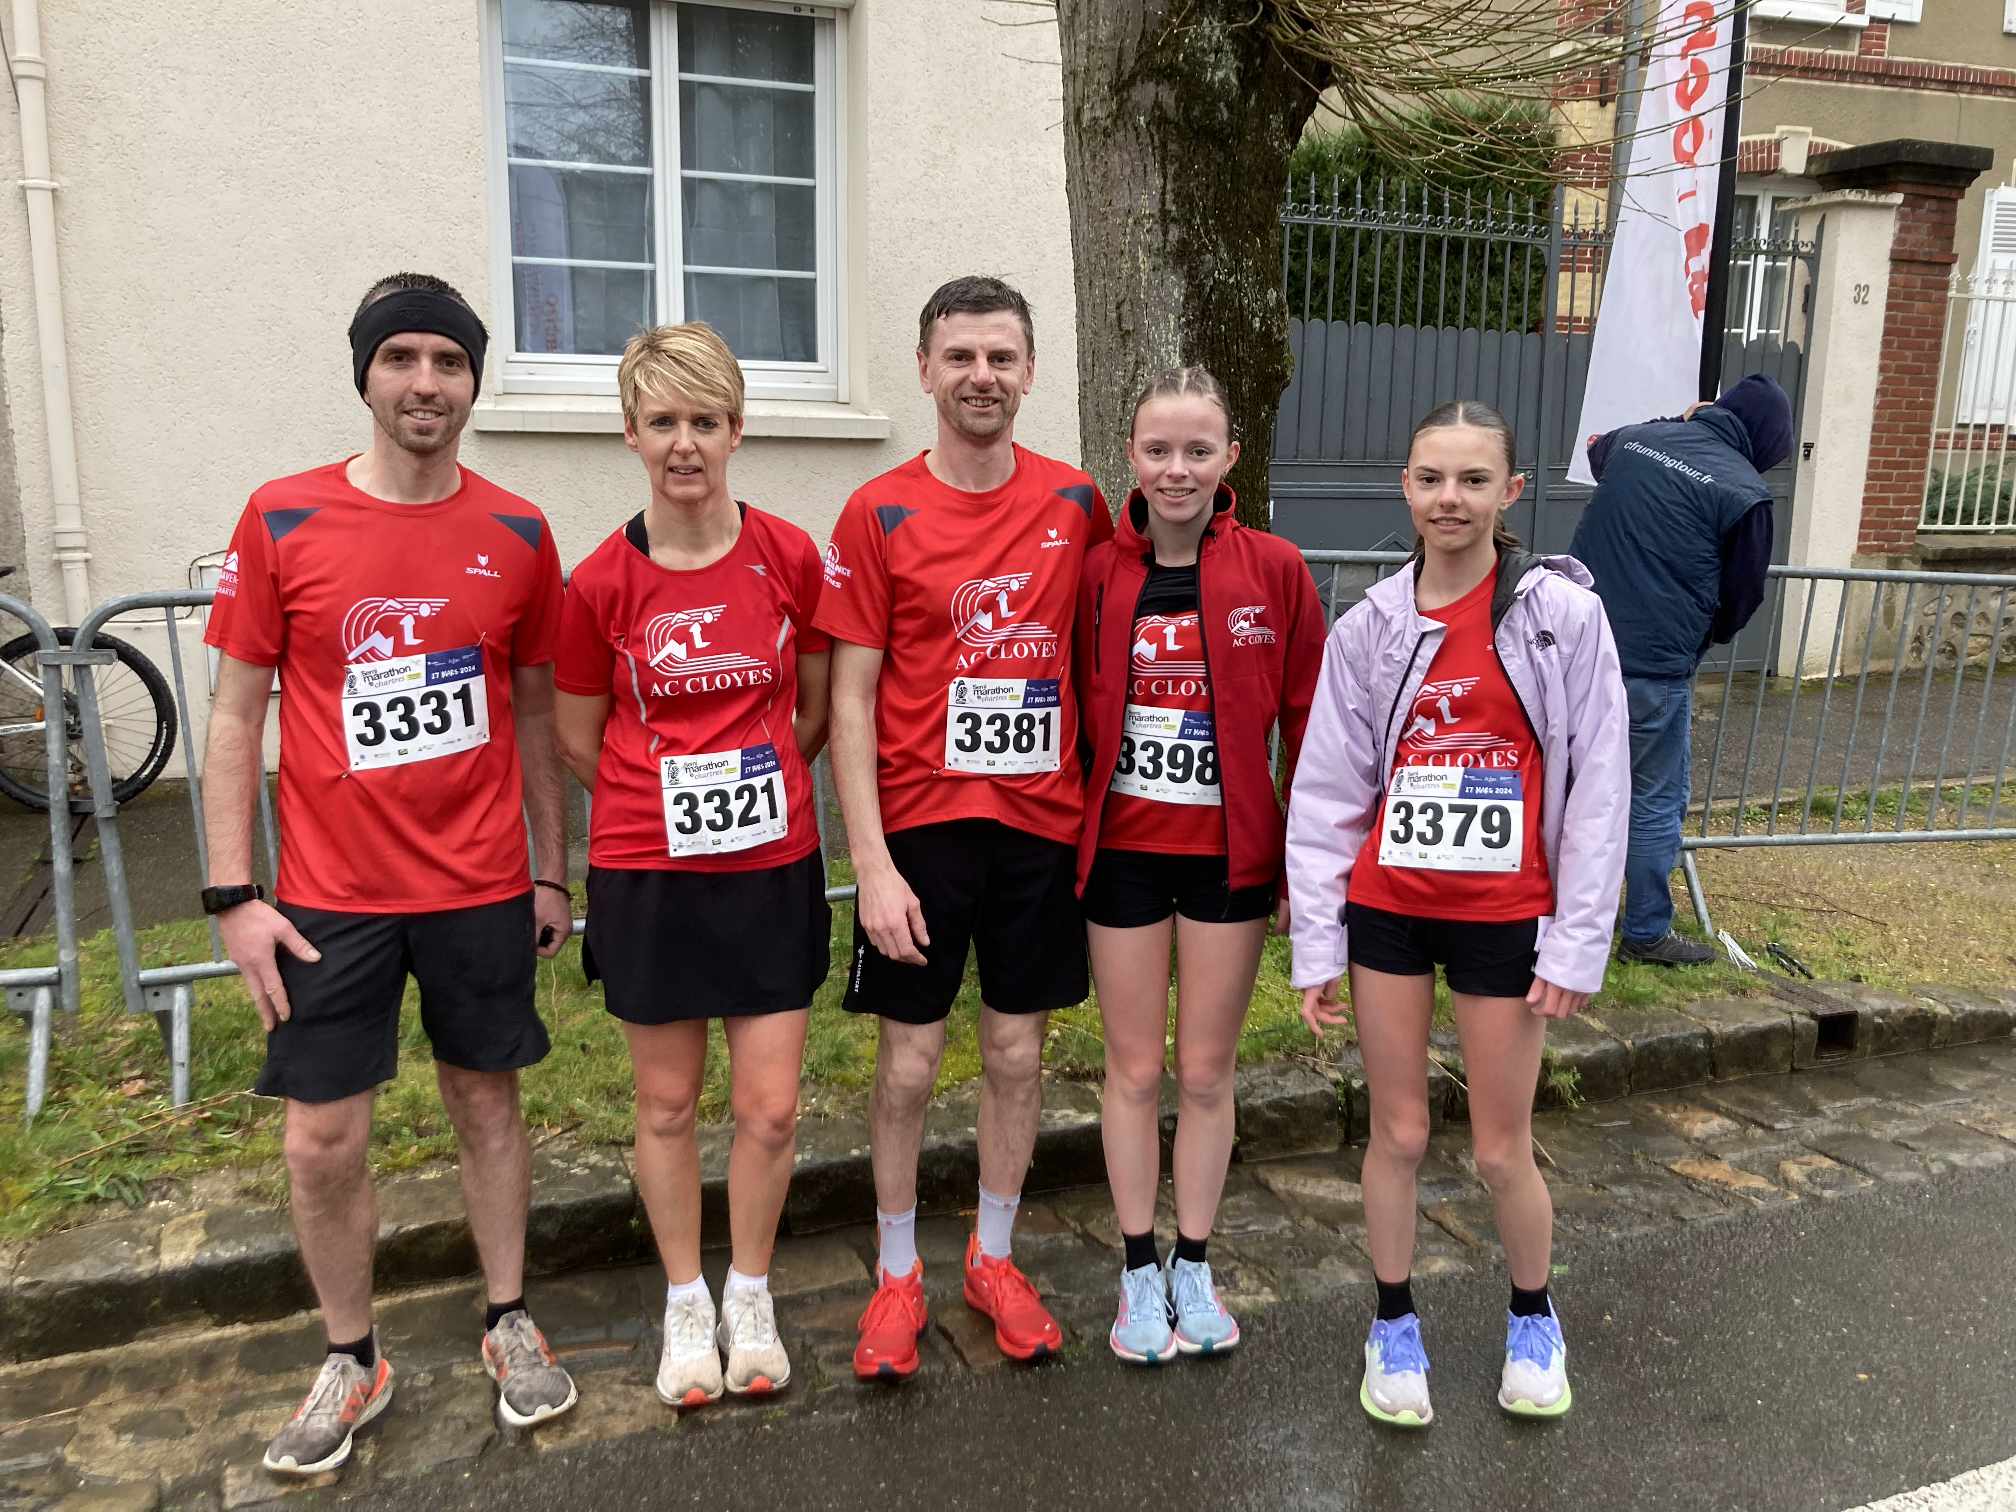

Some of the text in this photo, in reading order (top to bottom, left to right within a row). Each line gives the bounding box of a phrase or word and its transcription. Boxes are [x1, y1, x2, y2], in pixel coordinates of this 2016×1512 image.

[1853, 284, 1870, 305] 32
[1623, 441, 1715, 484] cfrunningtour.fr
[465, 567, 502, 578] SPALL
[985, 641, 1058, 660] CLOYES
[1232, 637, 1247, 648] AC
[363, 665, 412, 683] marathon
[431, 672, 440, 680] 17
[460, 665, 476, 674] 2024
[650, 668, 773, 697] AC CLOYES
[973, 686, 1014, 696] marathon
[1129, 679, 1209, 696] C CLOY
[352, 683, 475, 747] 3331
[1128, 713, 1169, 723] marathon
[954, 711, 1052, 755] 3381
[685, 760, 729, 774] marathon
[1115, 735, 1220, 786] 3398
[744, 766, 752, 774] 17
[1408, 773, 1448, 783] marathon
[1494, 786, 1513, 794] 2024
[672, 777, 778, 835] 3321
[1390, 800, 1512, 849] 3379
